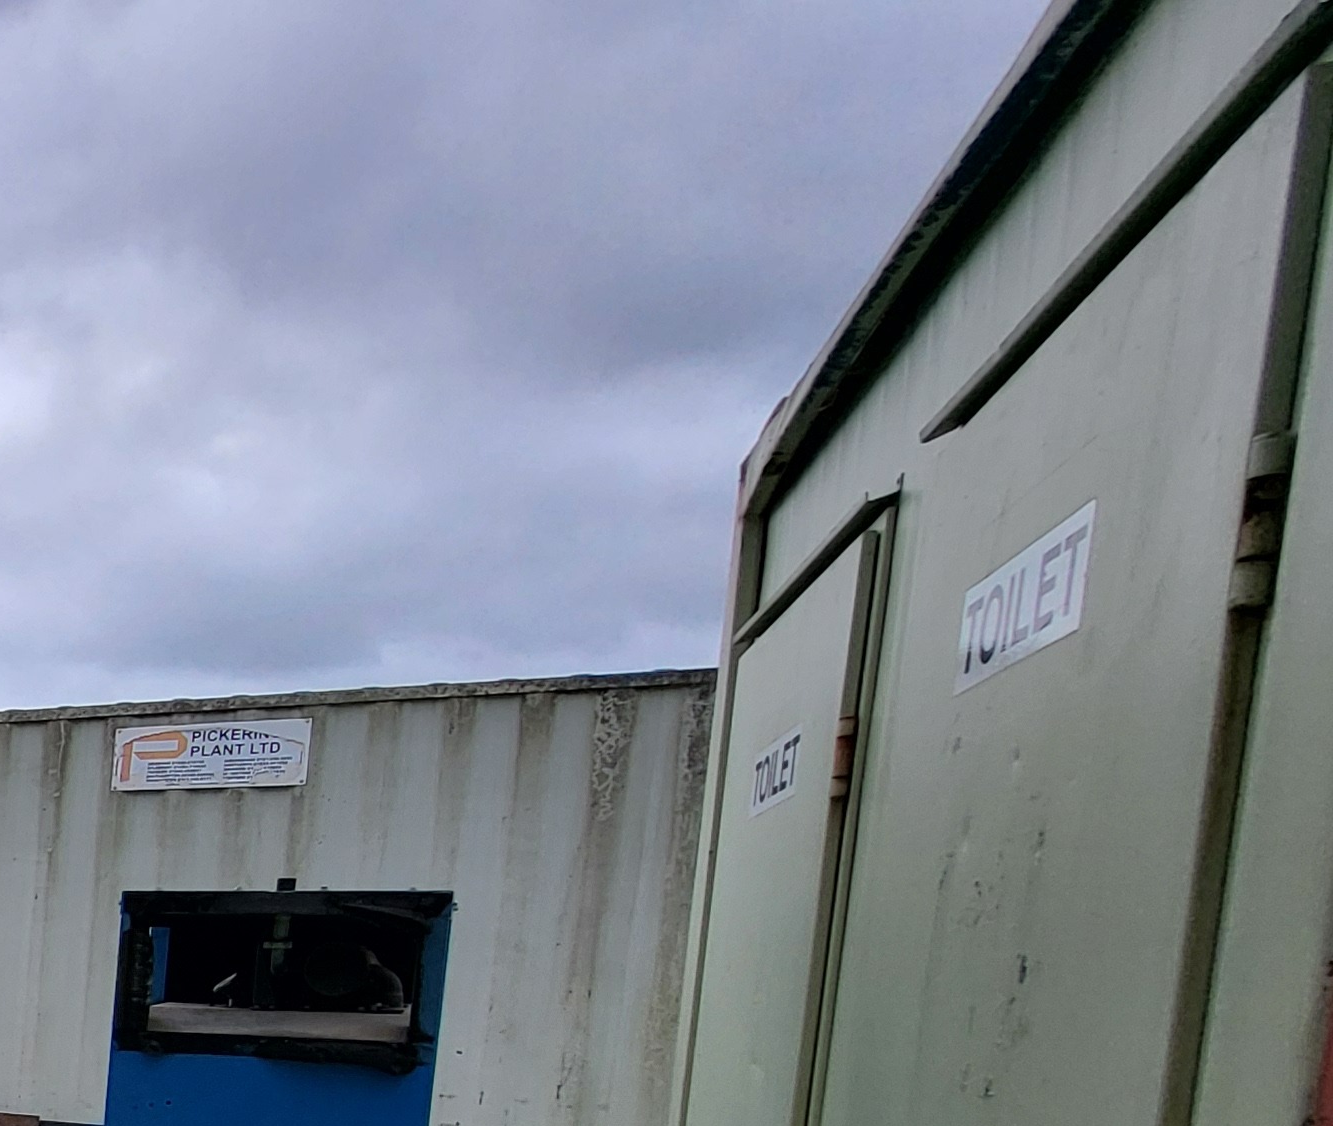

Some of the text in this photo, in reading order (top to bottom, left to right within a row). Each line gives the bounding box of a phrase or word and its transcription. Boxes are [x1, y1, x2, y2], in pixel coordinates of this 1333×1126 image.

[963, 523, 1090, 675] TOILET
[190, 741, 282, 758] PLANT LTD
[751, 733, 802, 808] TOILET
